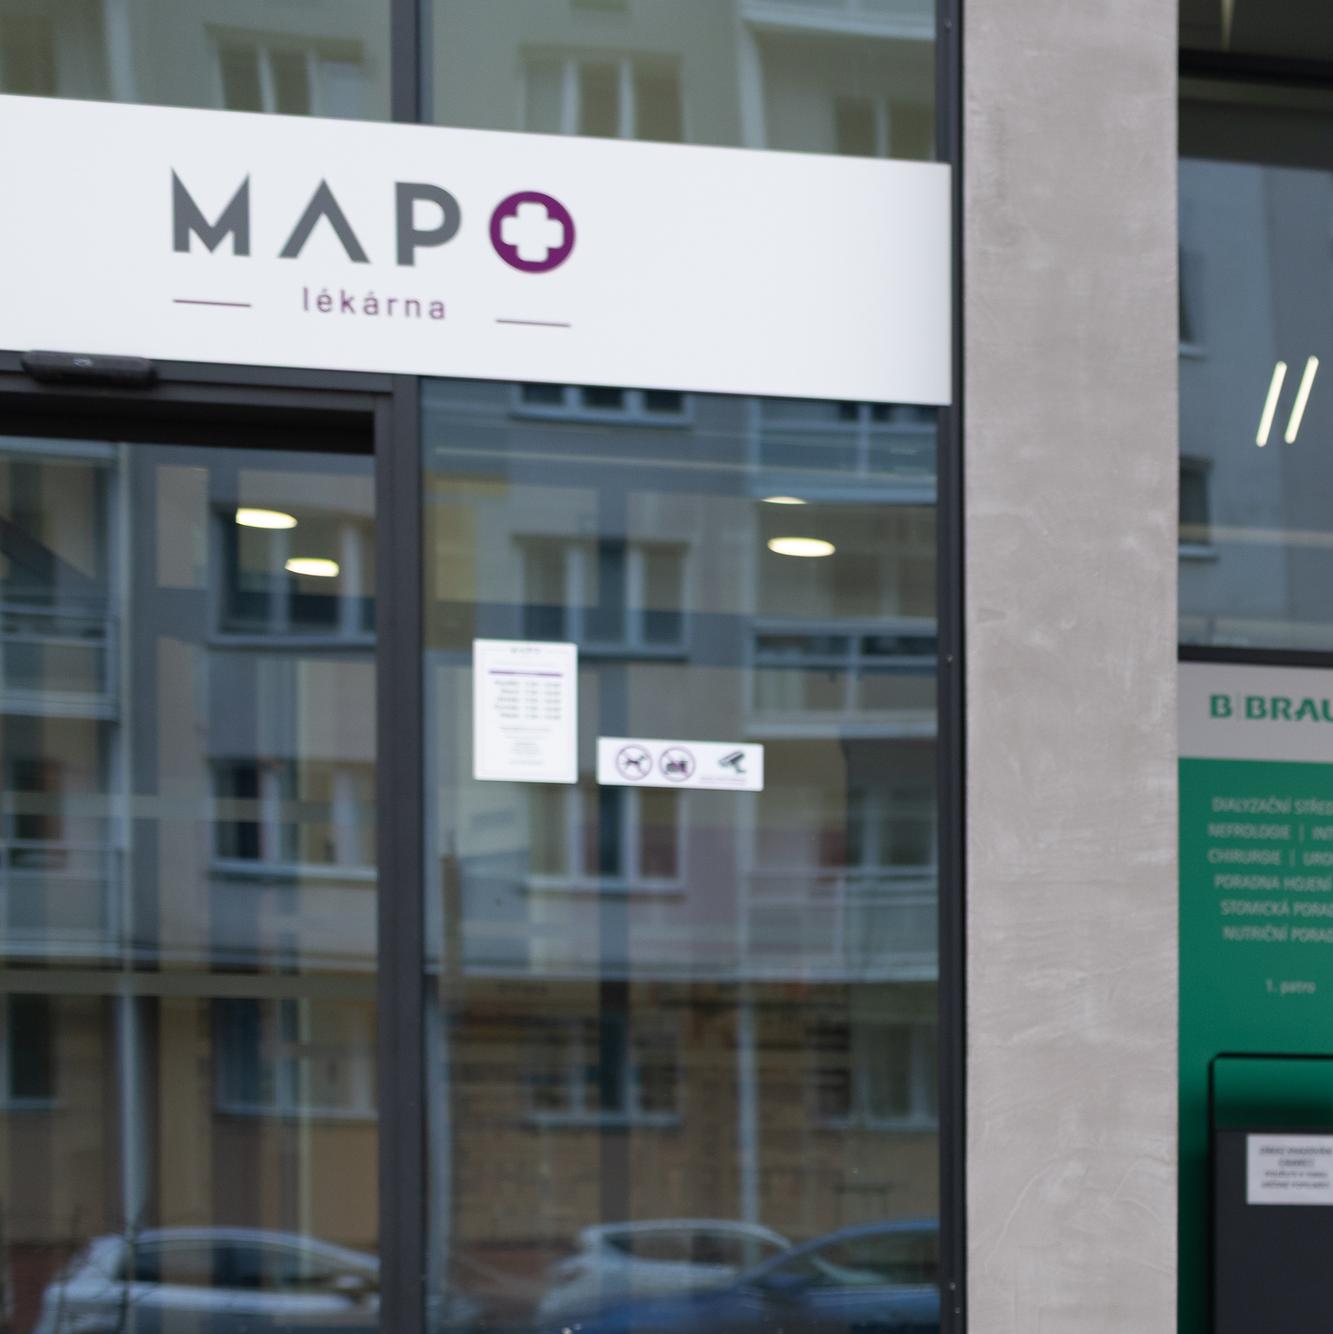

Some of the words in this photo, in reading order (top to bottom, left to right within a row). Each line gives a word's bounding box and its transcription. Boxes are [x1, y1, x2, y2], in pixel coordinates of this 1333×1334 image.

[302, 287, 447, 320] lékárna
[1207, 822, 1291, 840] NEFROLOGIE
[1207, 849, 1282, 866] CHIRURGIE
[1214, 874, 1281, 891] PORADNA
